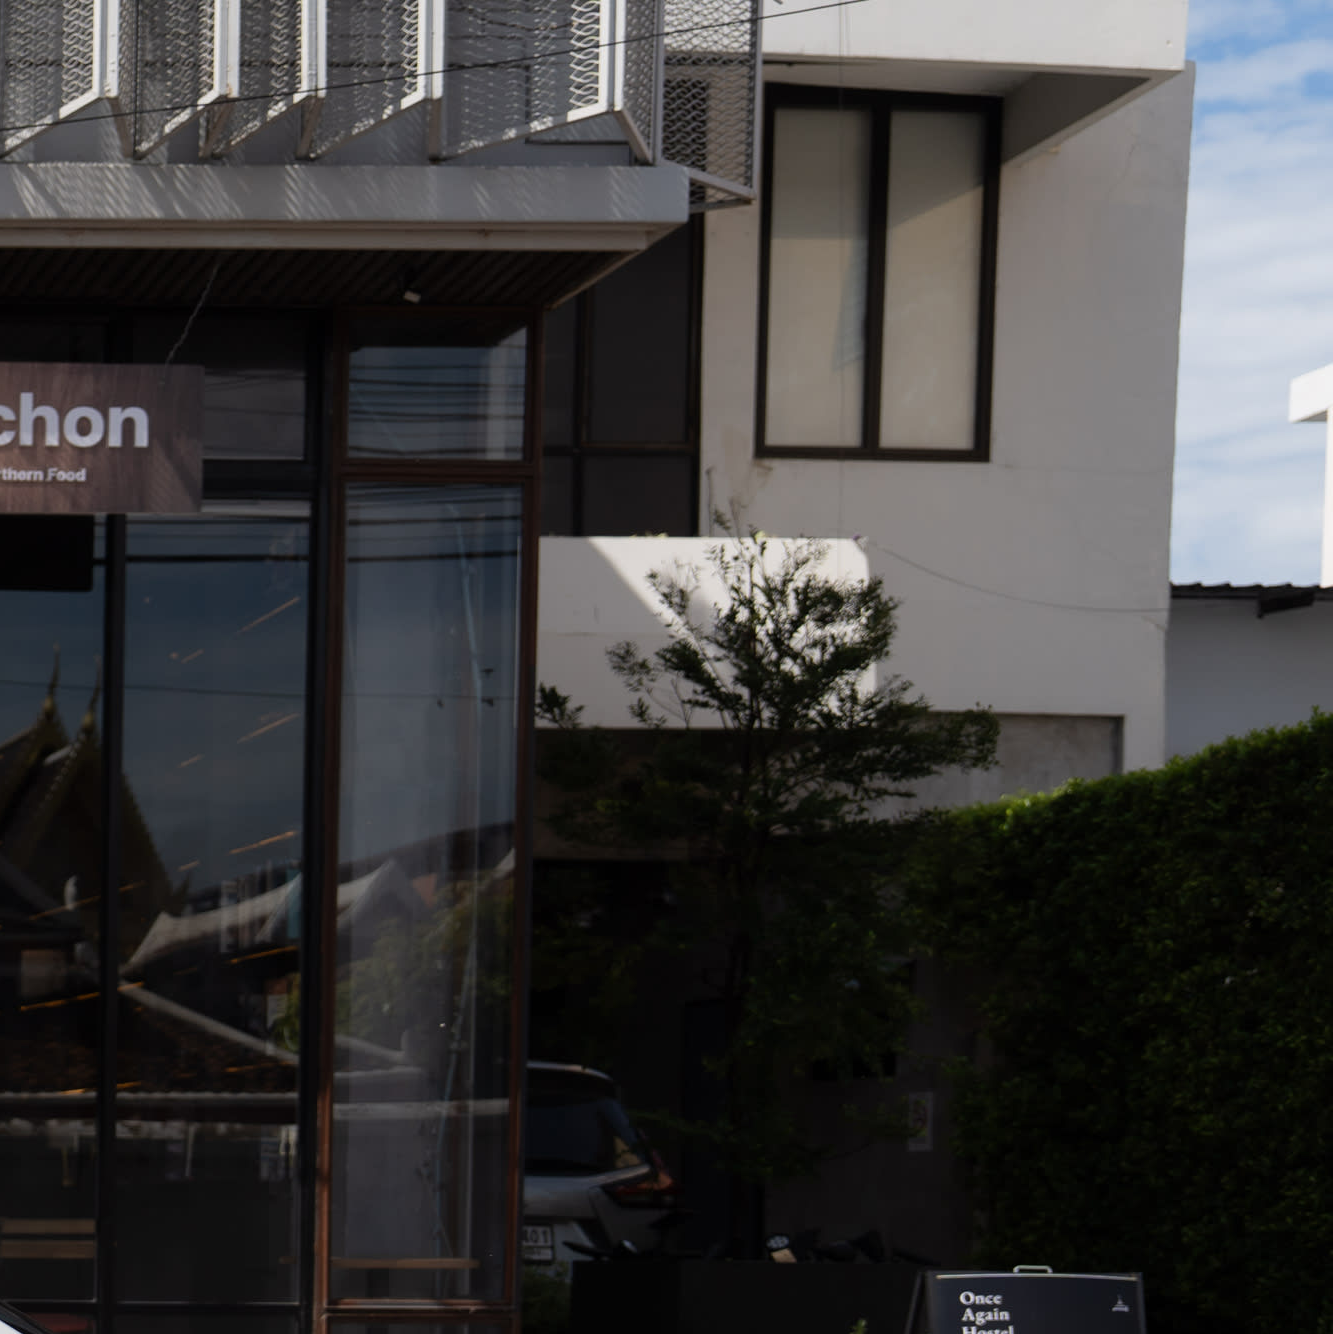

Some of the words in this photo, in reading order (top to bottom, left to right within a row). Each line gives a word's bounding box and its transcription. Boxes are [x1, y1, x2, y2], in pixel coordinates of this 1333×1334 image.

[45, 468, 87, 482] Food
[959, 1291, 1003, 1306] Once
[961, 1308, 1010, 1325] Again
